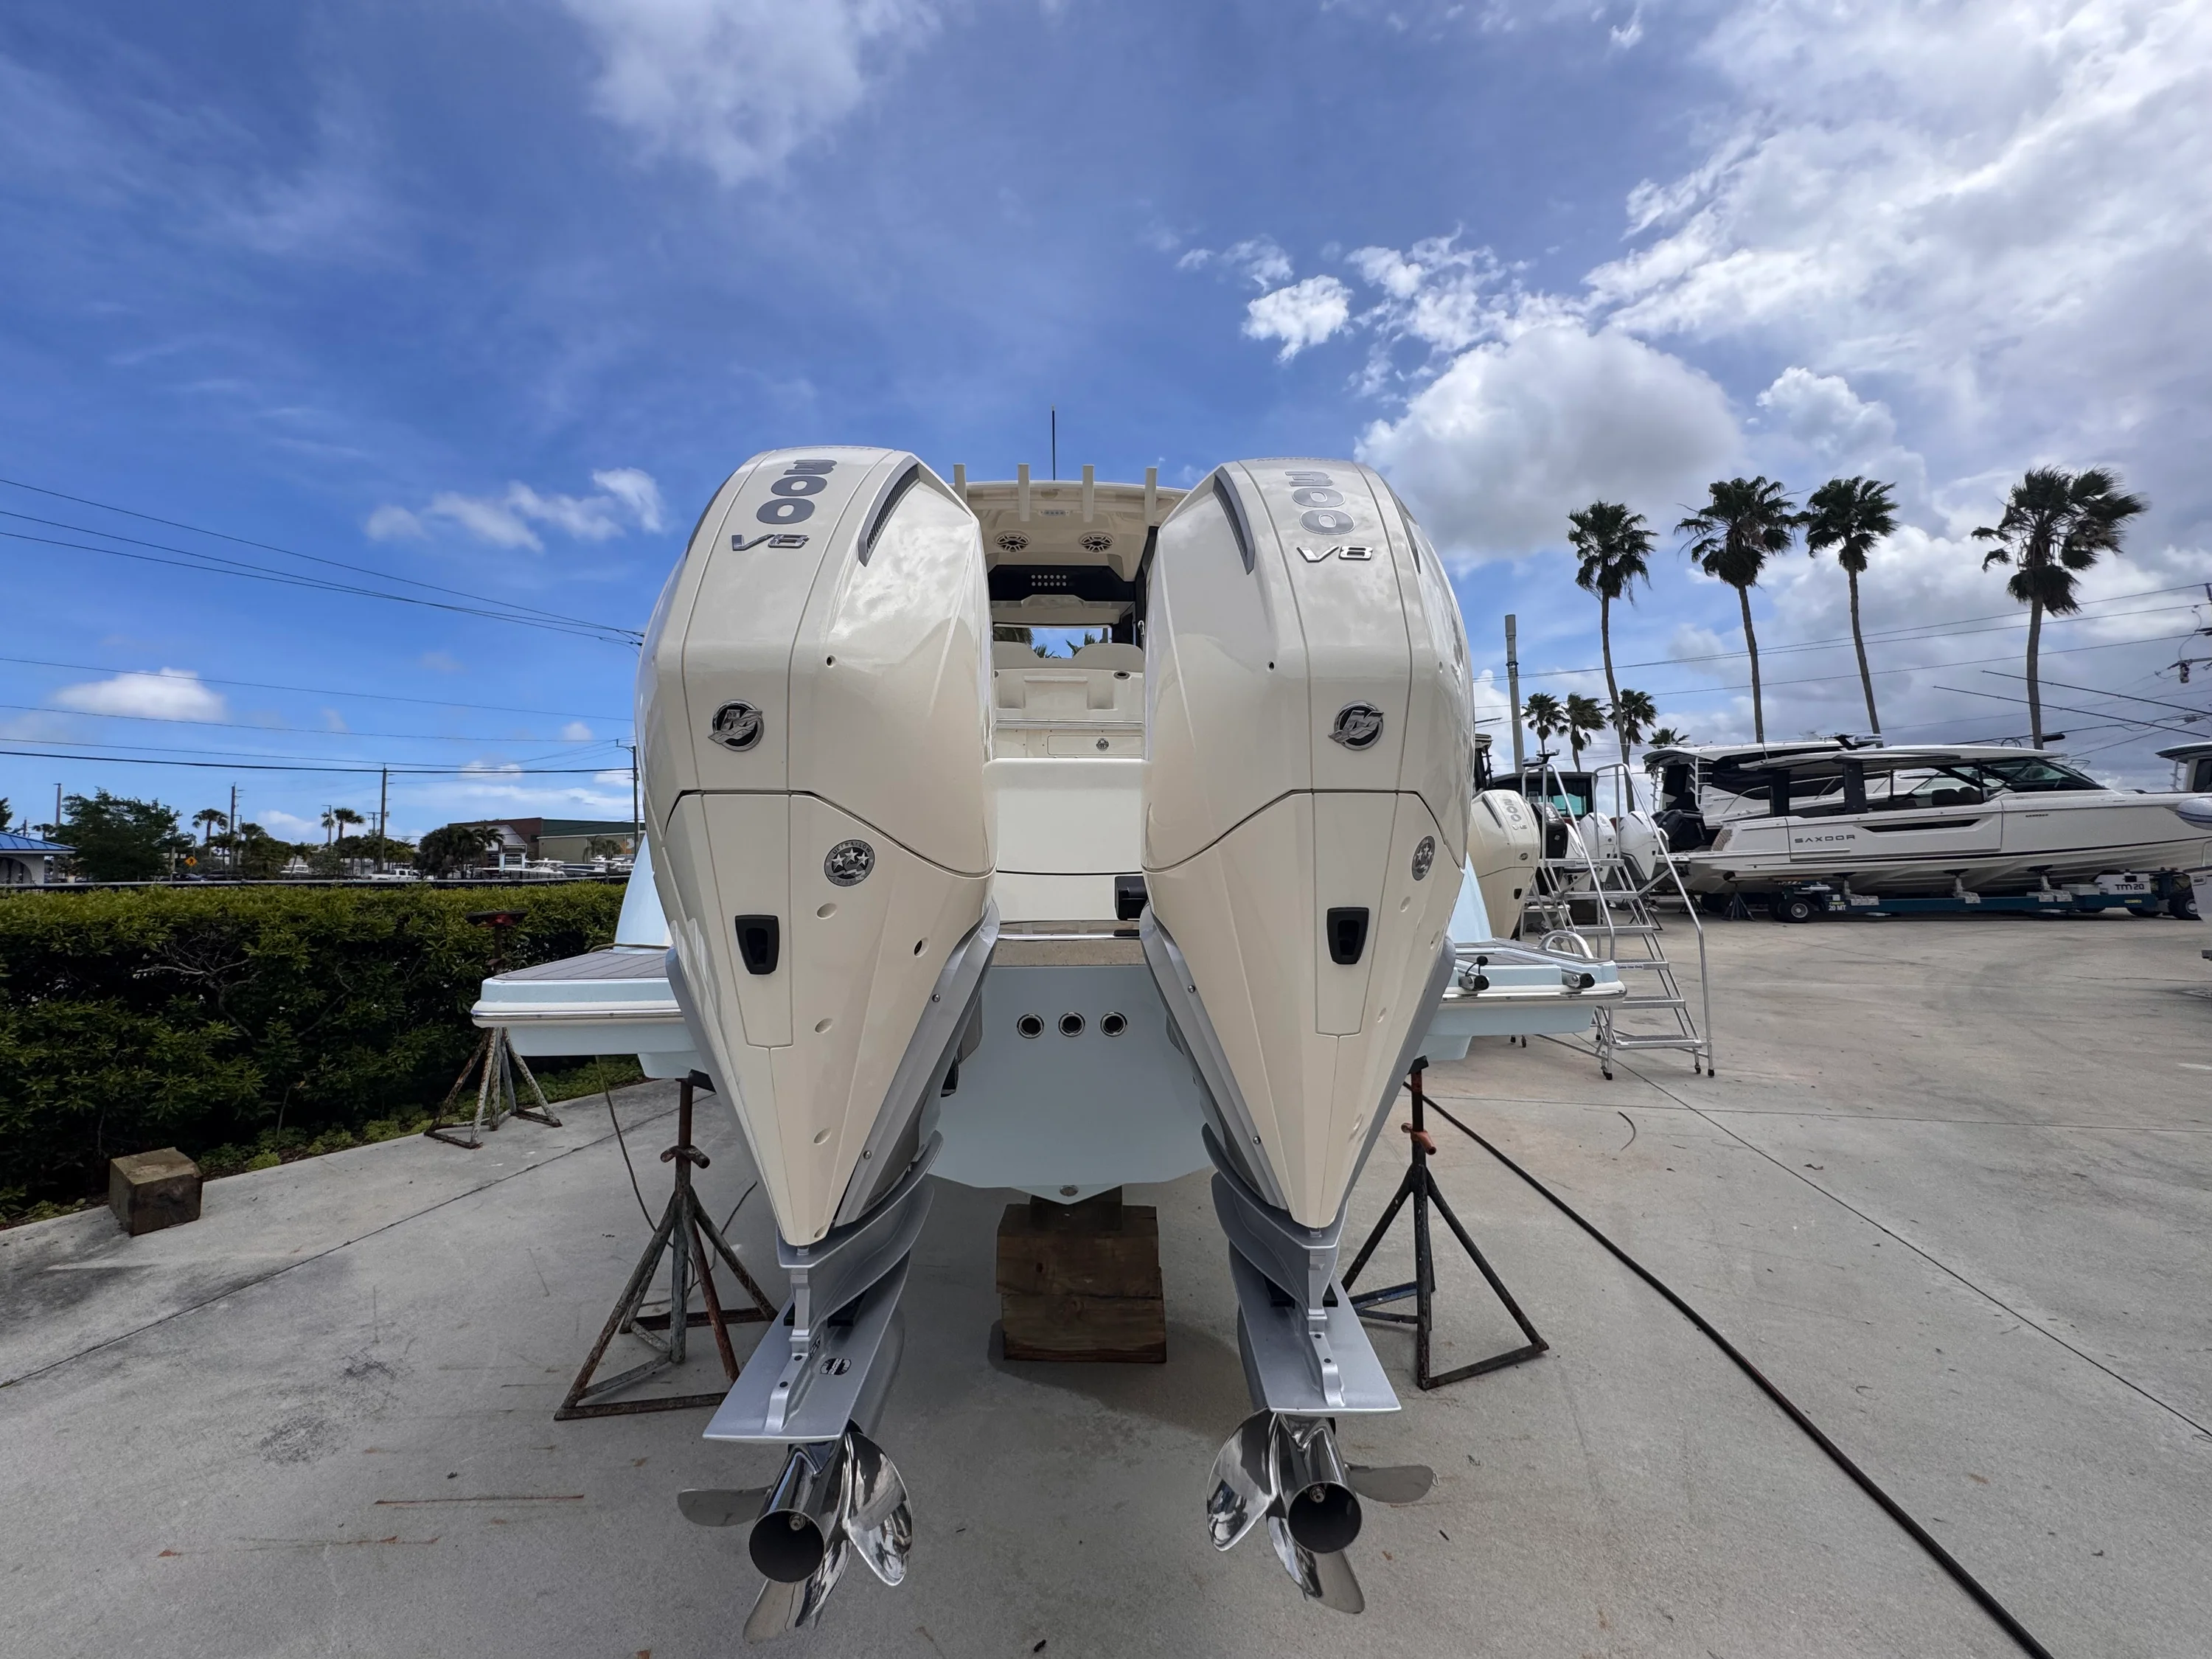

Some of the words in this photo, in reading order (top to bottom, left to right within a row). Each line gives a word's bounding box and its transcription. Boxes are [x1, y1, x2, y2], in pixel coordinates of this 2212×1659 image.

[757, 459, 837, 524] 300
[1284, 471, 1355, 535] 300
[731, 534, 810, 551] V8
[1296, 546, 1373, 563] V8
[1795, 835, 1855, 843] SAXDOR
